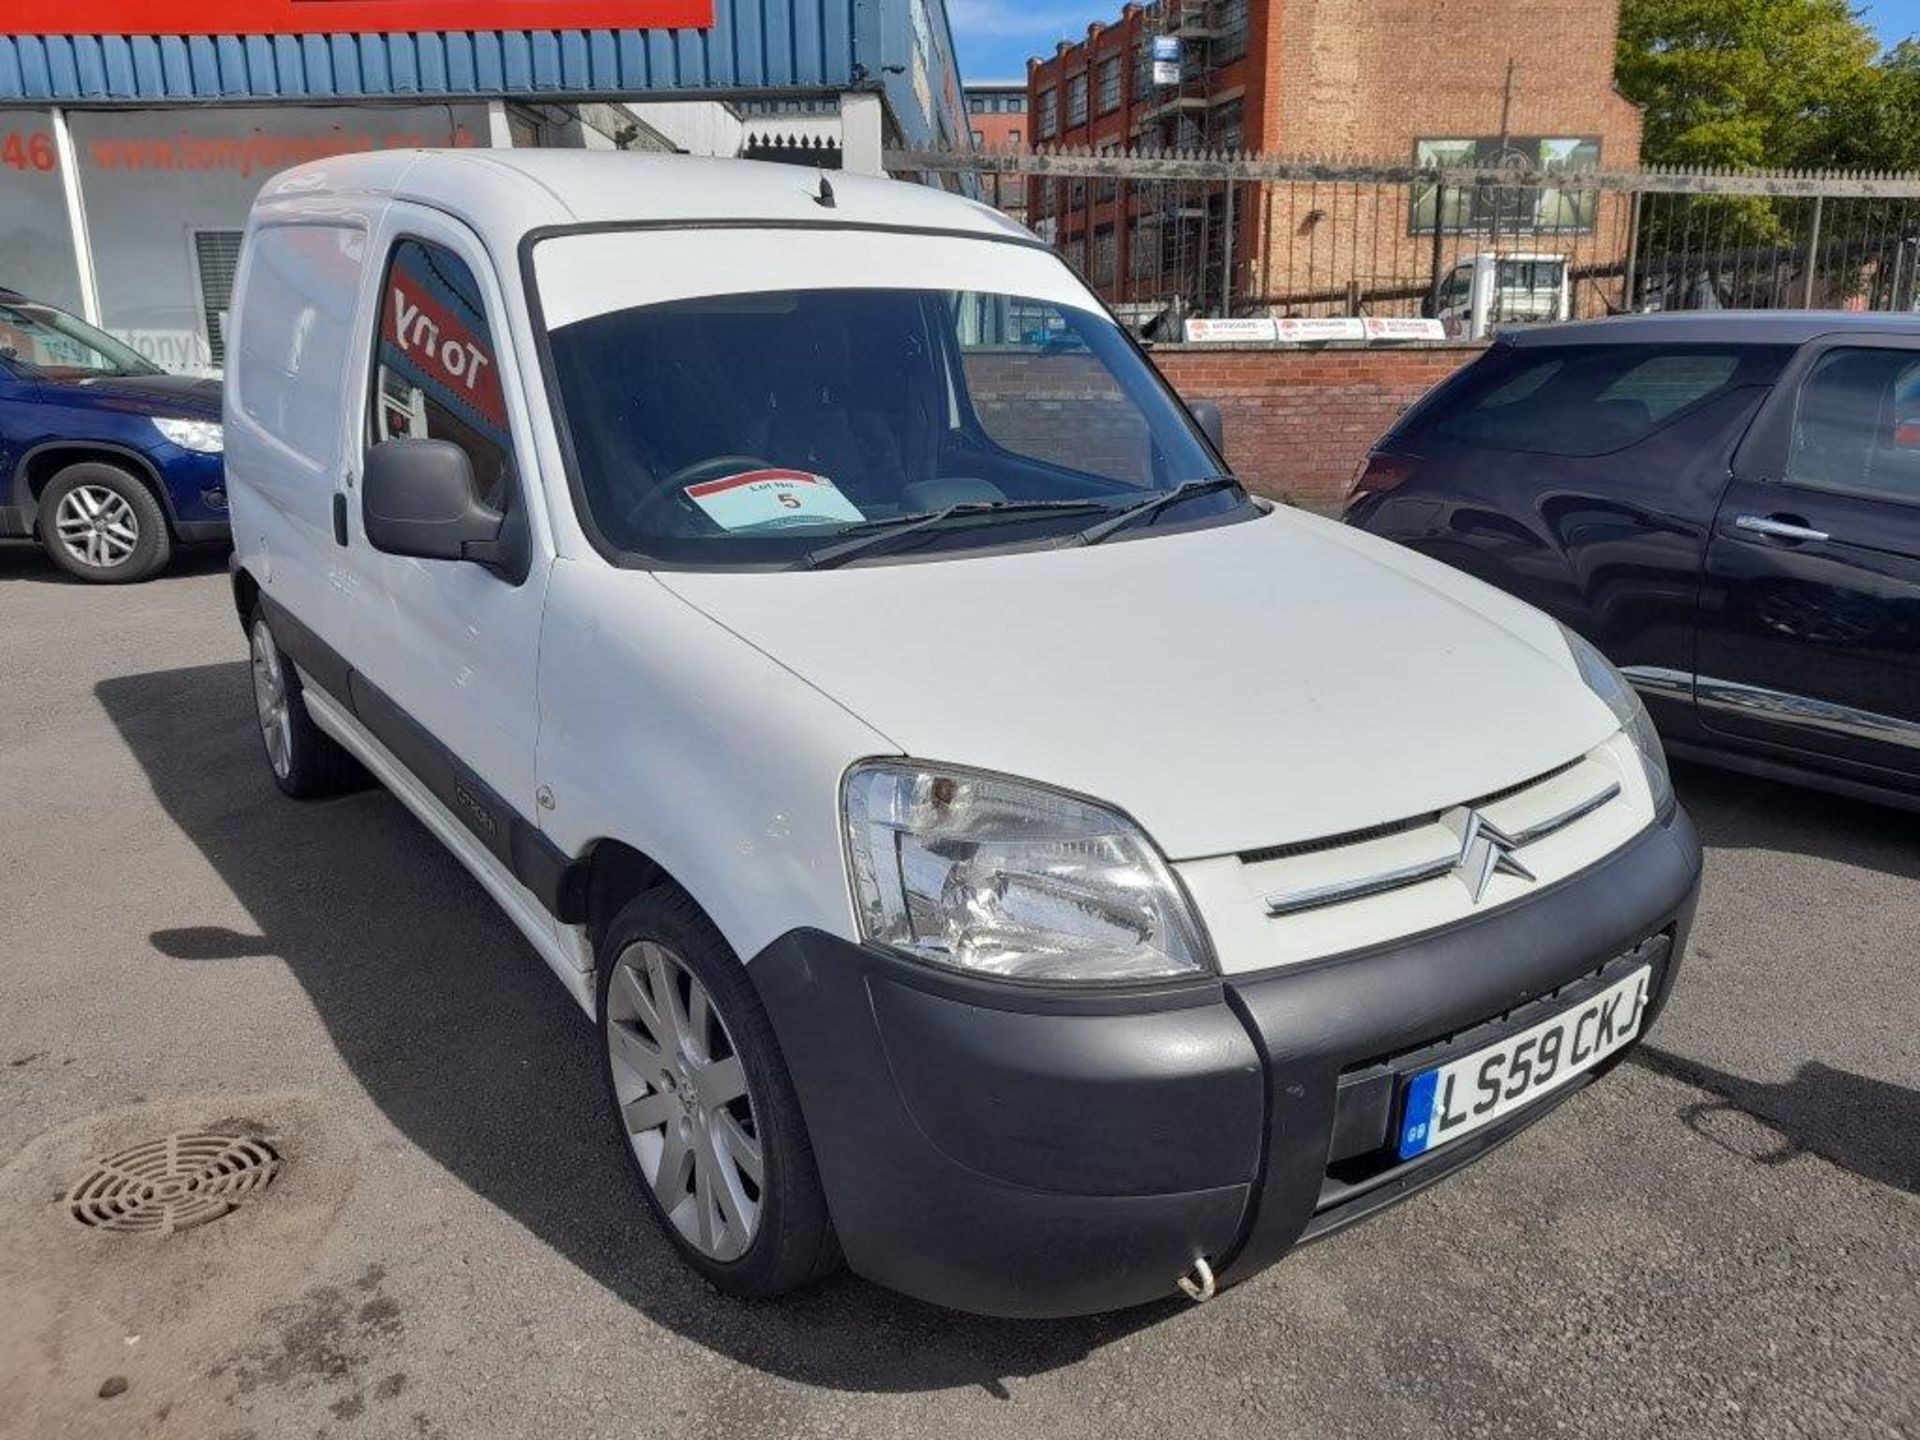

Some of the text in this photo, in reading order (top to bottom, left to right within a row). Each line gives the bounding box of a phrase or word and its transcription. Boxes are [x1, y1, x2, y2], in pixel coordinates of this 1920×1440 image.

[2, 131, 55, 171] 46
[750, 482, 772, 492] Lot
[777, 492, 802, 509] 5
[1439, 977, 1646, 1132] LS59 CKJ
